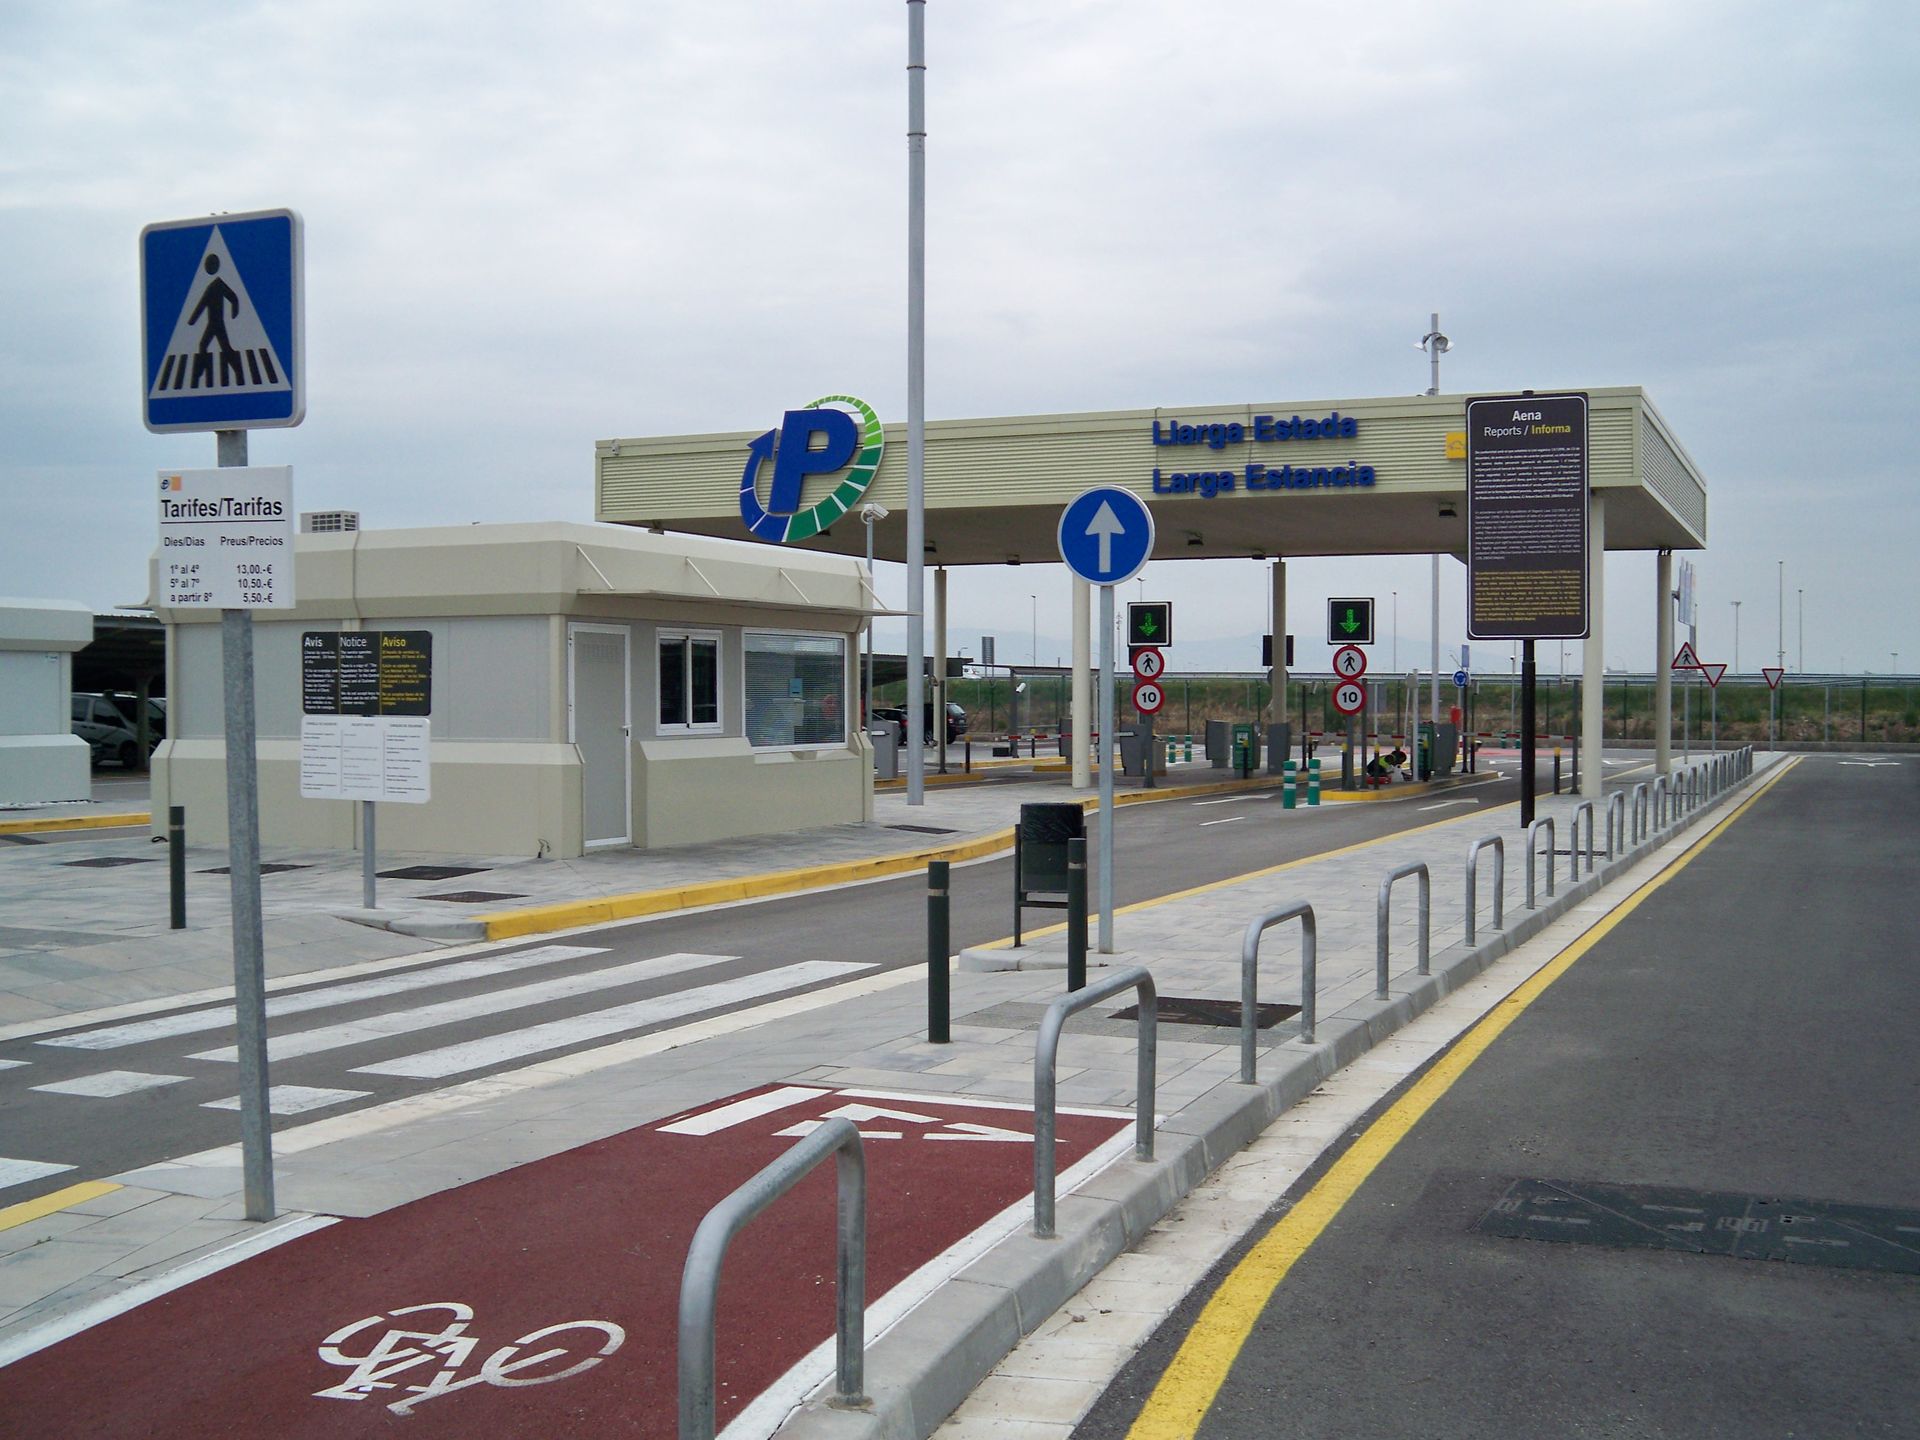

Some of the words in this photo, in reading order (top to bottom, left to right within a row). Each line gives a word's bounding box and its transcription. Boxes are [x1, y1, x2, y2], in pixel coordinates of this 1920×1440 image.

[1511, 411, 1542, 422] Aena
[1153, 420, 1243, 451] Llarga
[1253, 411, 1358, 443] Estada
[1483, 426, 1522, 439] Reports
[1523, 425, 1529, 436] /
[1531, 424, 1572, 436] Informa
[768, 409, 858, 513] P
[1153, 467, 1236, 499] Larga
[1245, 460, 1377, 491] Estancia
[161, 496, 283, 518] Tarifes/Tarifas
[219, 535, 285, 546] Preus/Precios
[181, 564, 189, 574] al
[181, 578, 189, 588] al
[170, 594, 177, 603] a
[178, 592, 202, 605] partir
[340, 636, 368, 648] Notice
[382, 636, 407, 648] Aviso
[1141, 692, 1158, 704] 10
[1341, 691, 1359, 704] 10
